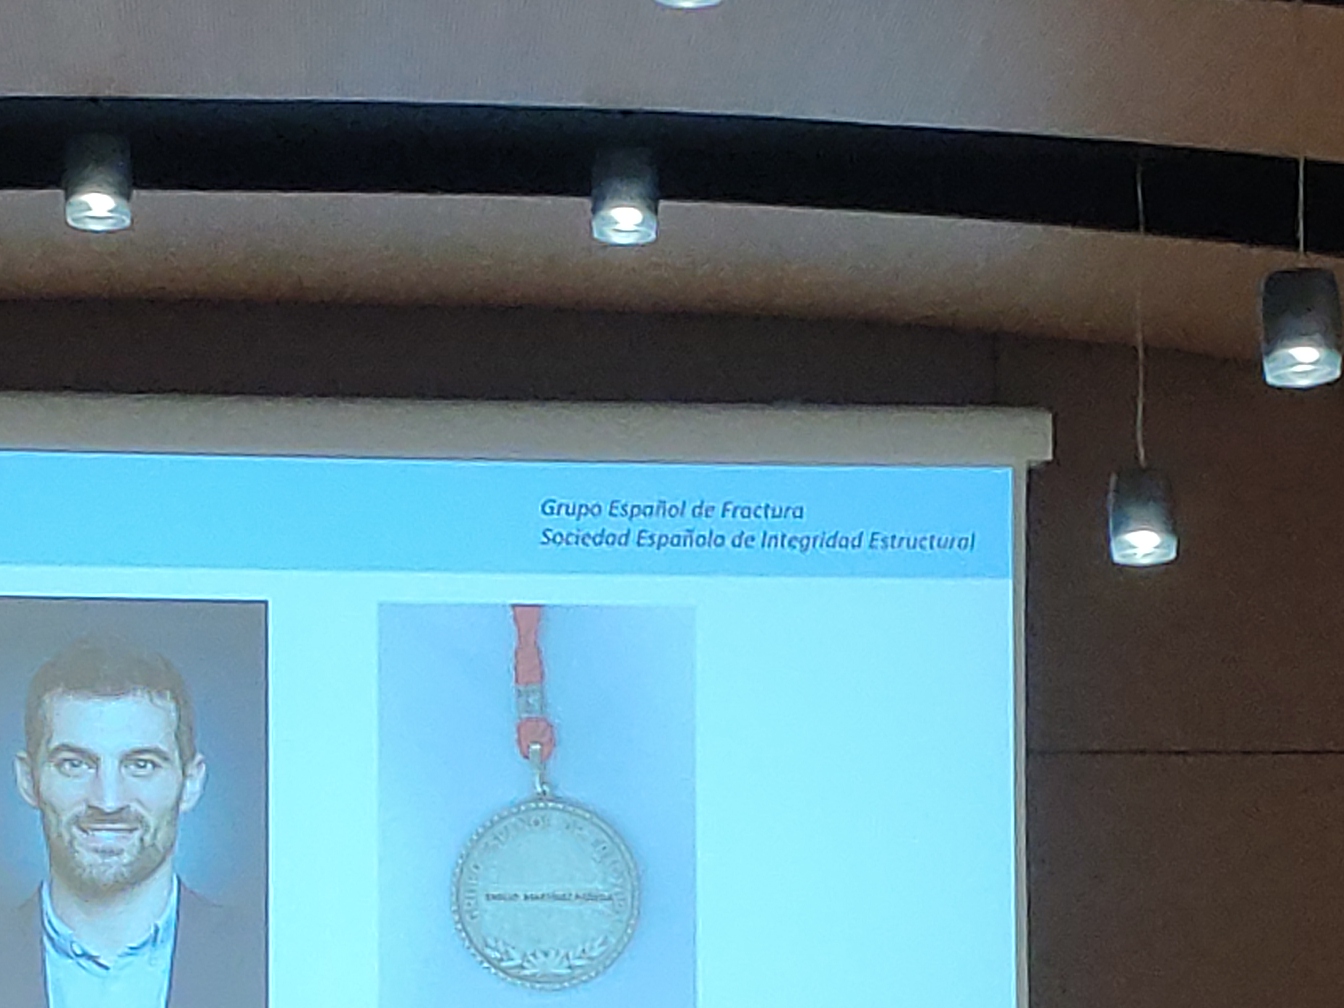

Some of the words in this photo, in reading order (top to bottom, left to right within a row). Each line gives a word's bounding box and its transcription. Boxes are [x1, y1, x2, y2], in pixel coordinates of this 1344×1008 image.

[540, 499, 602, 521] Grupo
[609, 499, 686, 520] Español
[692, 500, 715, 518] de
[721, 501, 804, 519] Fractura
[541, 528, 631, 547] Sociedad
[636, 529, 726, 550] Española
[731, 530, 755, 548] de
[761, 530, 864, 552] Integridad
[869, 531, 976, 552] Estructural
